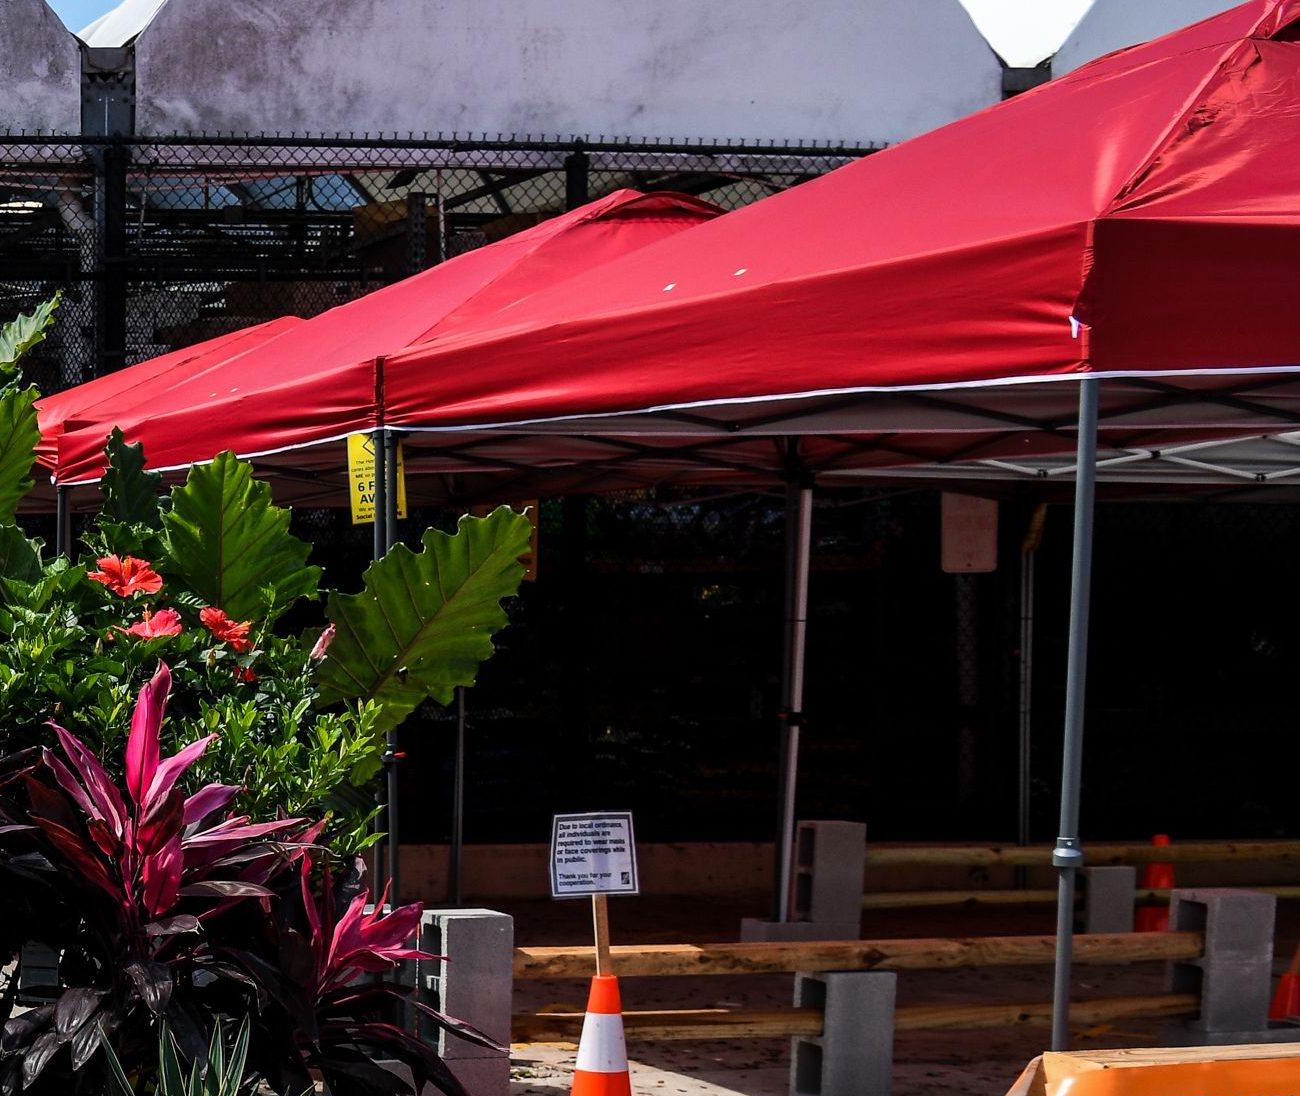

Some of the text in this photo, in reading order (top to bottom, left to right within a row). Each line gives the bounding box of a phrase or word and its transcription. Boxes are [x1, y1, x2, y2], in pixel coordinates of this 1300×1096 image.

[358, 482, 365, 492] 6
[567, 830, 600, 838] individuals
[580, 847, 611, 855] coverings
